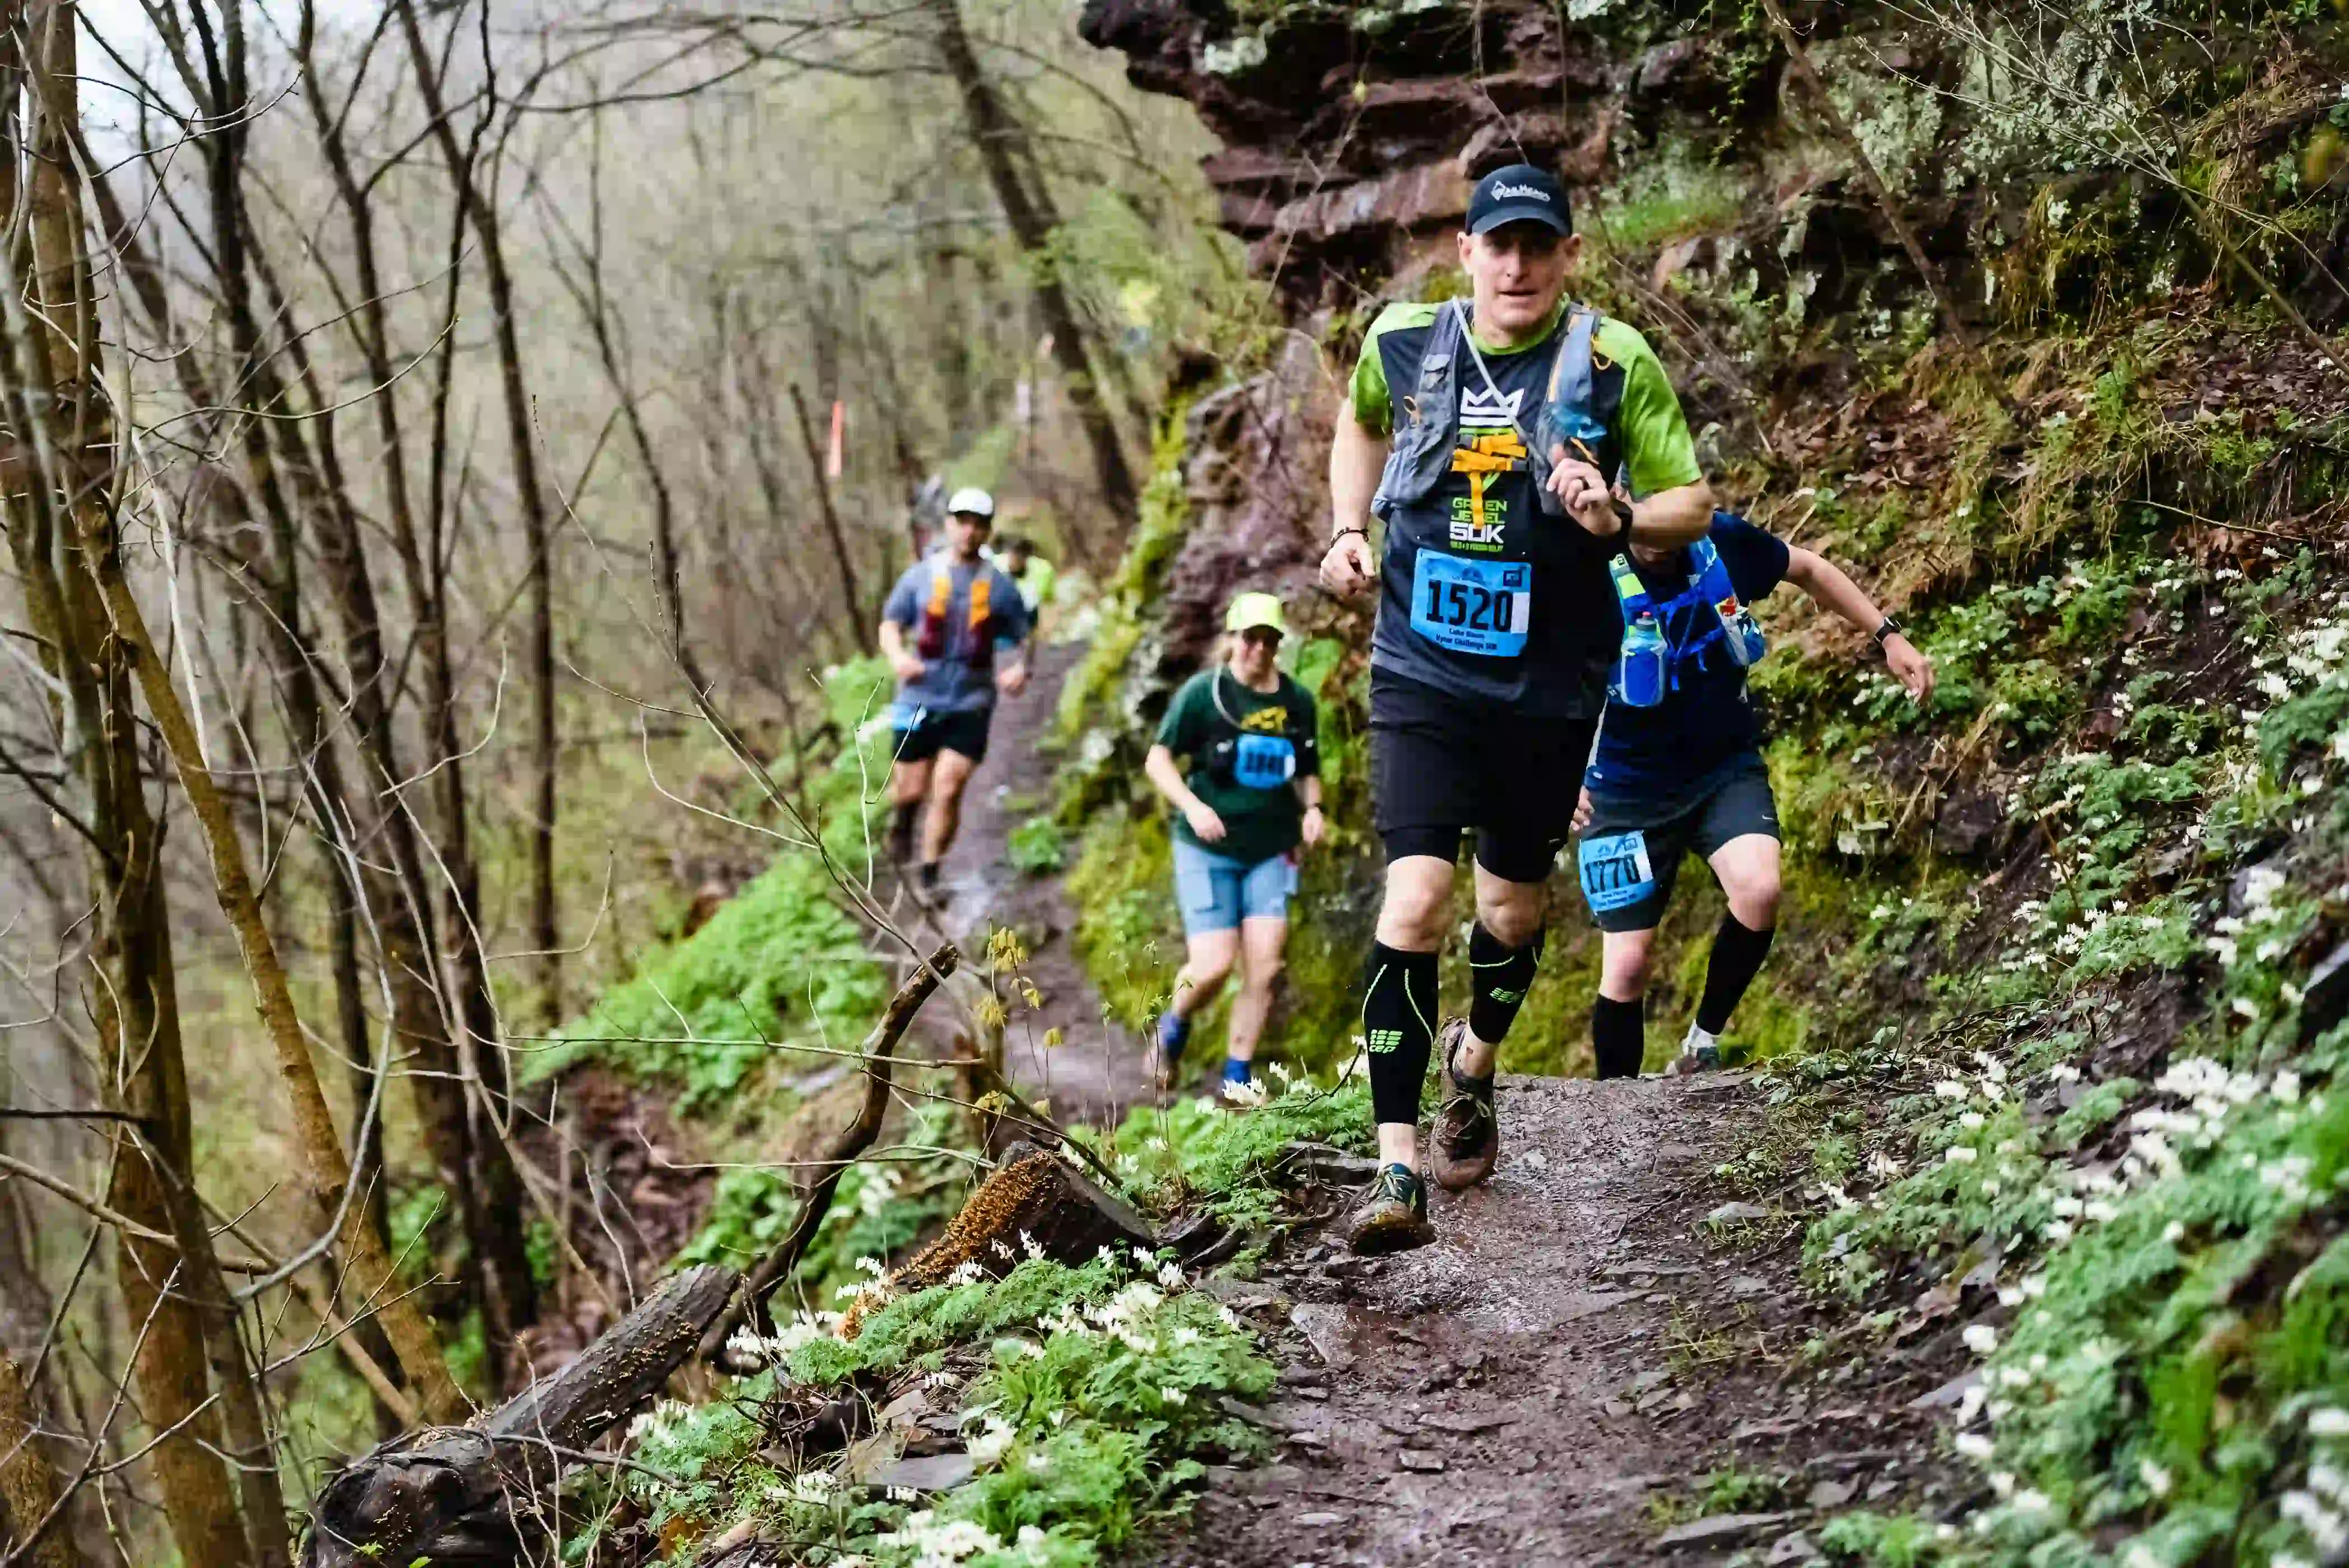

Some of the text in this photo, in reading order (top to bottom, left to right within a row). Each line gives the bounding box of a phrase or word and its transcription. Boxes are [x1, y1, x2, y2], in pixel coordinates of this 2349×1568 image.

[1452, 497, 1508, 512] GREN
[1450, 510, 1506, 524] JEEL
[1450, 521, 1506, 544] 50K
[1427, 580, 1513, 632] 1520
[1584, 853, 1642, 895] 1770
[1369, 1045, 1396, 1053] cep
